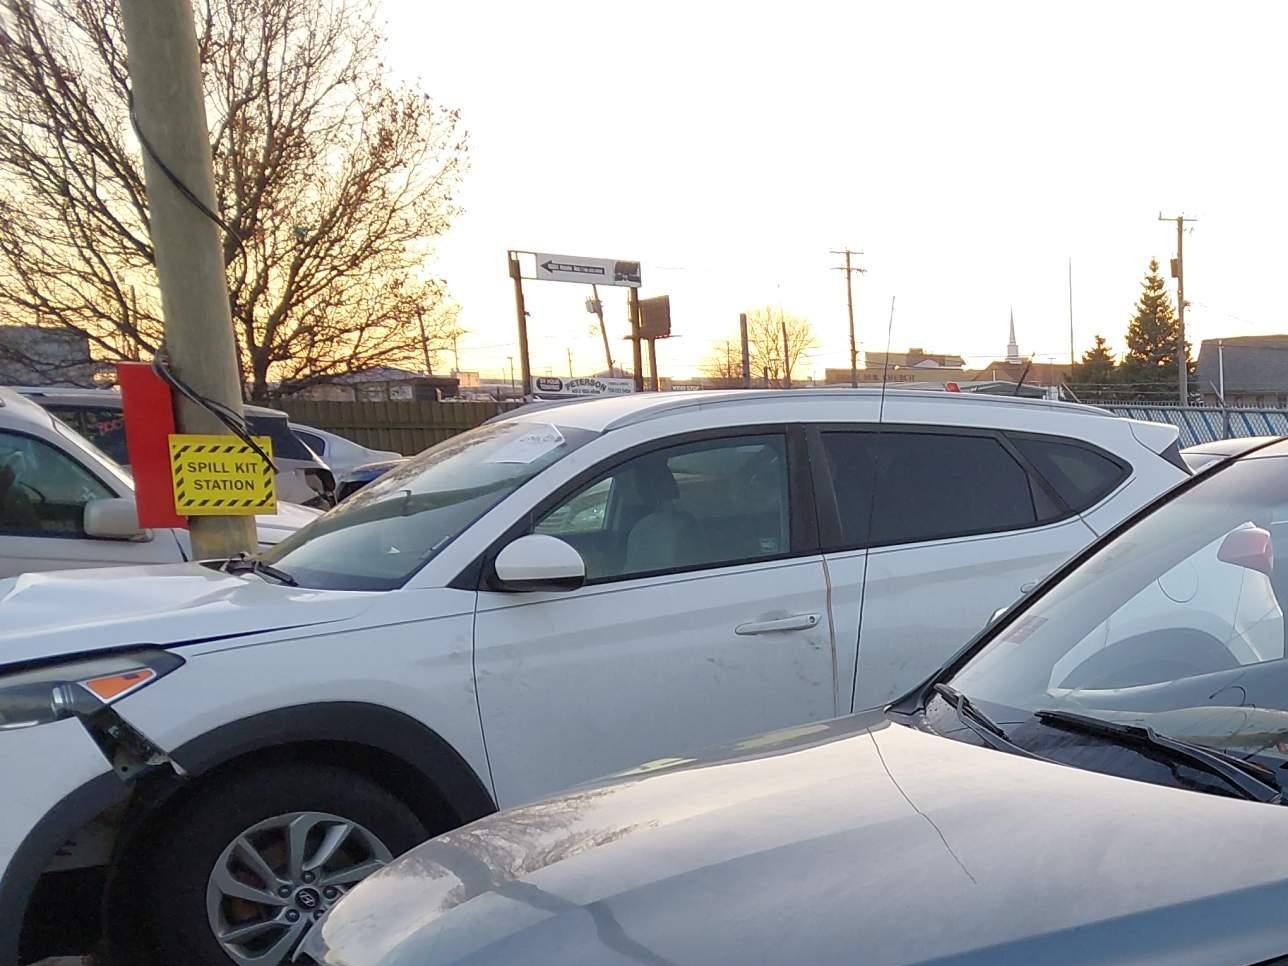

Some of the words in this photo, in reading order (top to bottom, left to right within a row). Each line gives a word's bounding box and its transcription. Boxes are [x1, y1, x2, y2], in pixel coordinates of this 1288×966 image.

[565, 378, 607, 392] PETERSON
[187, 462, 230, 473] SPILL
[235, 462, 258, 473] KIT
[193, 479, 255, 490] STATION
